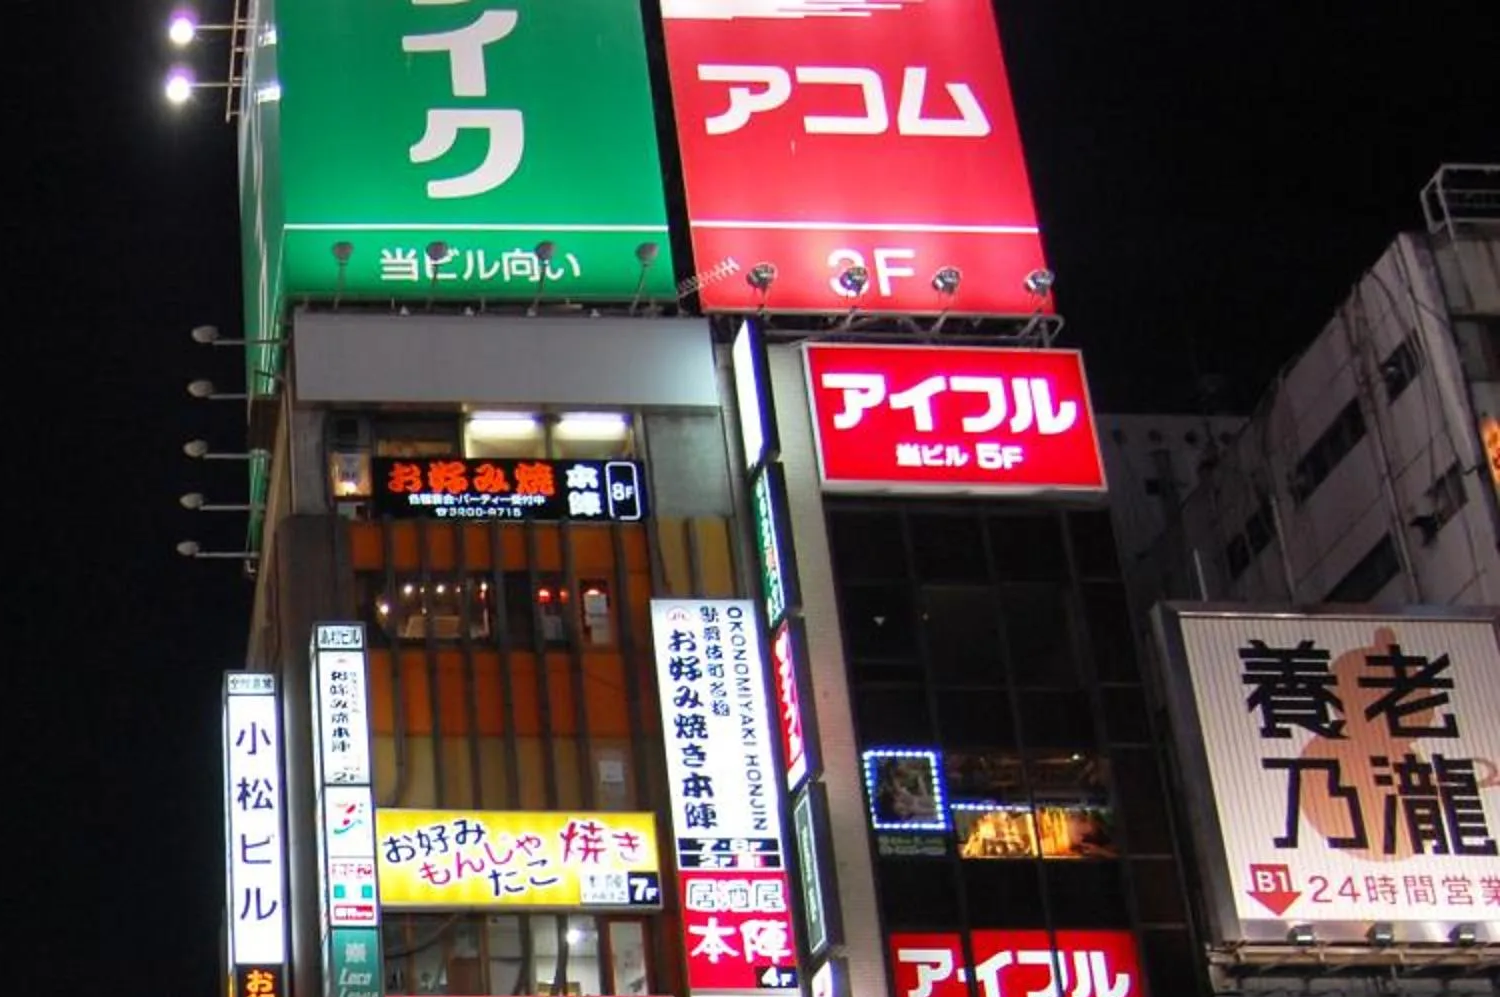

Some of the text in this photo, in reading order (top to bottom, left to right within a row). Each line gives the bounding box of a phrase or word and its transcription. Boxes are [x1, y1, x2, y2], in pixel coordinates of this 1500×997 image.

[401, 0, 525, 200] イク
[698, 66, 992, 137] アコム
[378, 246, 581, 283] 当ビル向い
[822, 373, 1077, 434] アイフル
[388, 461, 555, 496] お好み焼
[895, 444, 1024, 470] 当ビル 5F
[1238, 639, 1460, 739] 養老
[668, 629, 718, 830] お好み焼き本陣
[726, 606, 769, 832] OKONOMIYAKI HONJIN
[235, 721, 278, 921] 小松ビル
[1262, 753, 1499, 857] 乃瀧
[382, 818, 486, 863] お好み
[560, 820, 641, 864] 焼き
[488, 859, 559, 897] たこ
[629, 876, 659, 900] 7F
[686, 879, 786, 913] 居酒屋
[1253, 868, 1288, 892] B1
[1307, 873, 1500, 908] 24時間営業
[688, 917, 792, 964] 本陣
[760, 967, 793, 987] 4F
